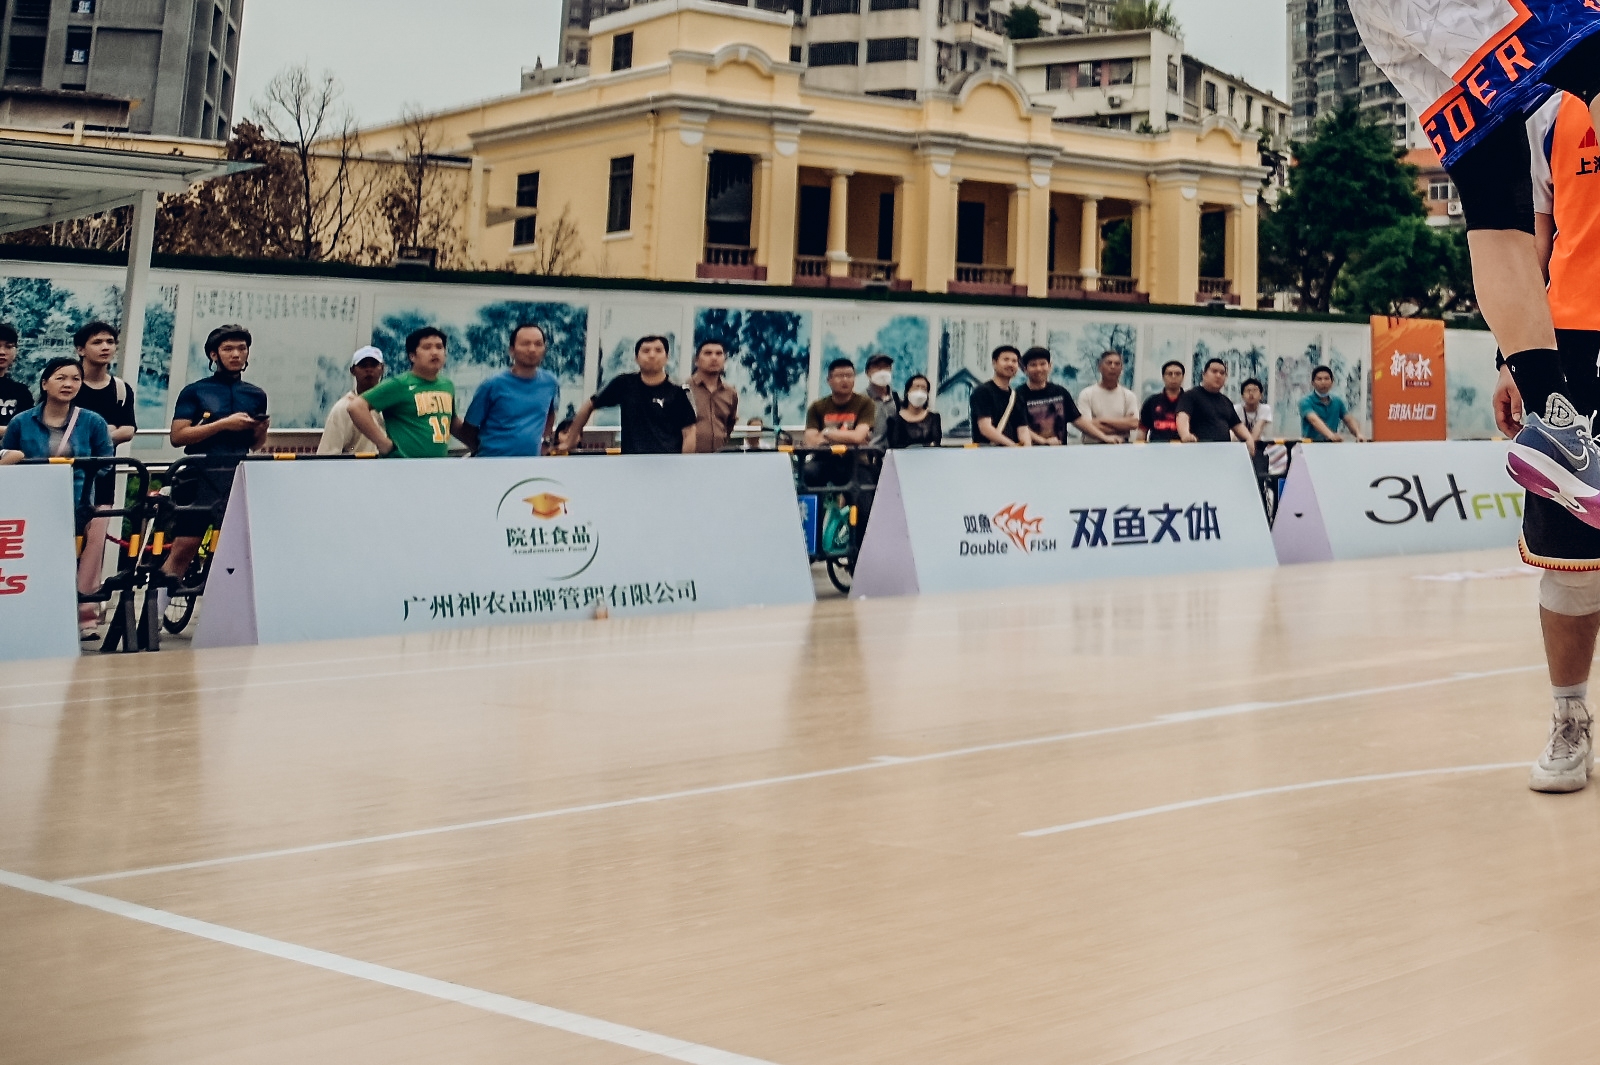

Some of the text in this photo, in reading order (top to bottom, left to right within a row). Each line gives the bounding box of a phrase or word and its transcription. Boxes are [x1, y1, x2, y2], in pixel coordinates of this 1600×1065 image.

[1388, 403, 1437, 421] 球队出口
[1471, 492, 1524, 520] FIT
[506, 525, 591, 547] 院仕食品
[1069, 501, 1221, 549] 双鱼文体
[959, 539, 1057, 556] Double FISH
[403, 579, 698, 622] 广州神农品牌管理有限公司
